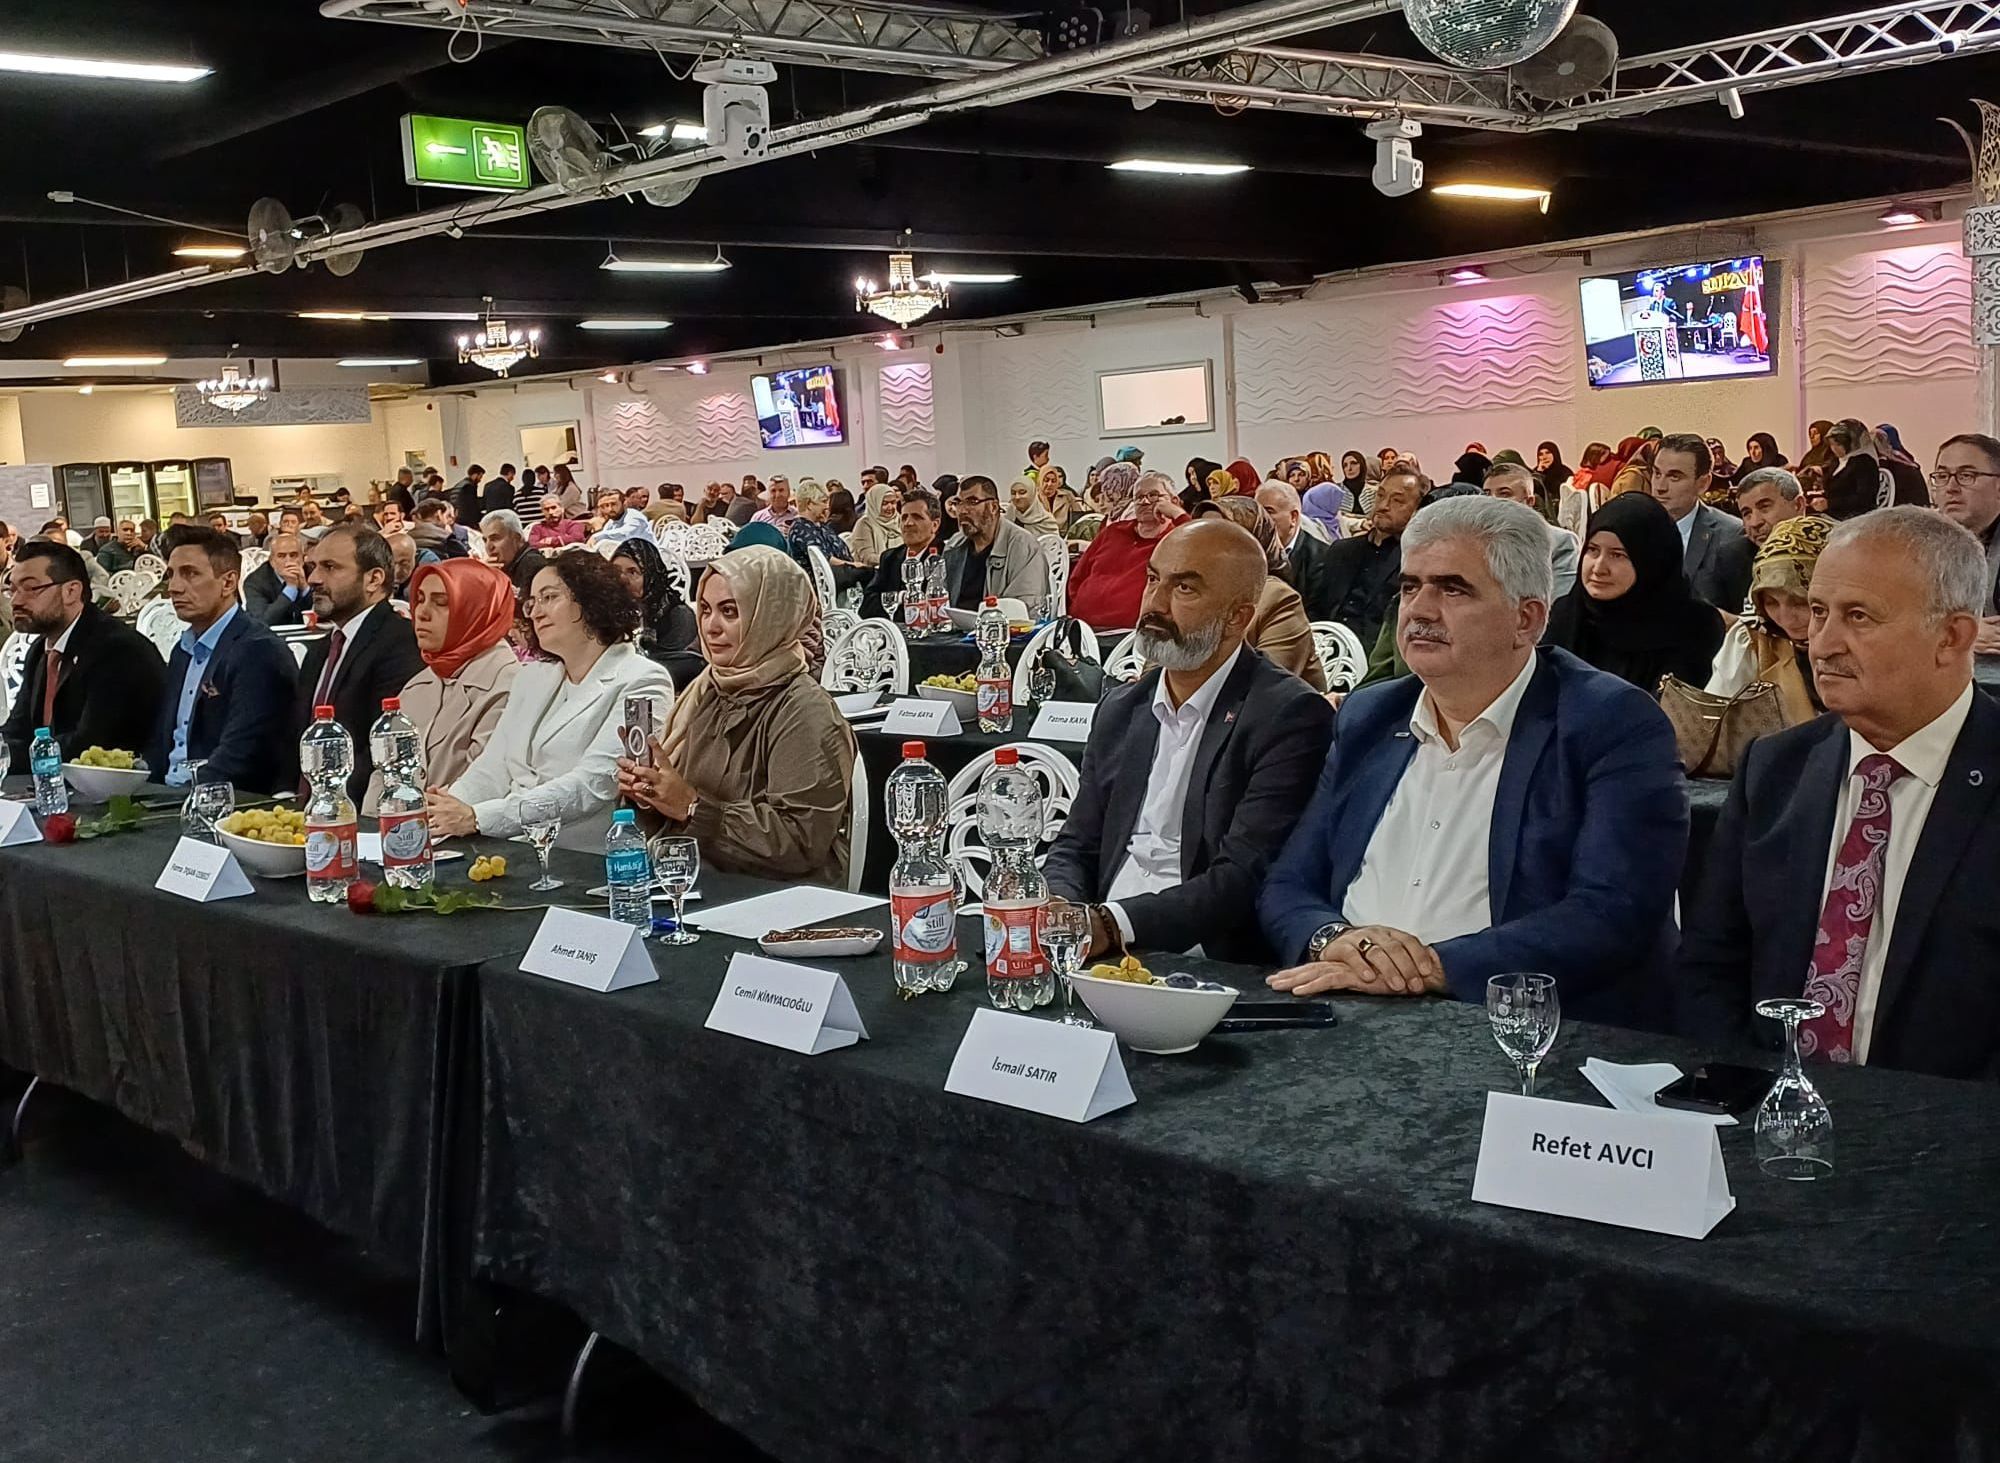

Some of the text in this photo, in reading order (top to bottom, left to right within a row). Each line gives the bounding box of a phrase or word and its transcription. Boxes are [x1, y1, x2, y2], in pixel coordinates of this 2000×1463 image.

[926, 913, 945, 929] still
[551, 944, 598, 965] Ahmet TANIŞ
[734, 985, 813, 1013] Cemil KİMYACIOĞLU
[1025, 1065, 1058, 1084] SATIR
[1532, 1132, 1654, 1170] Refet AVCI
